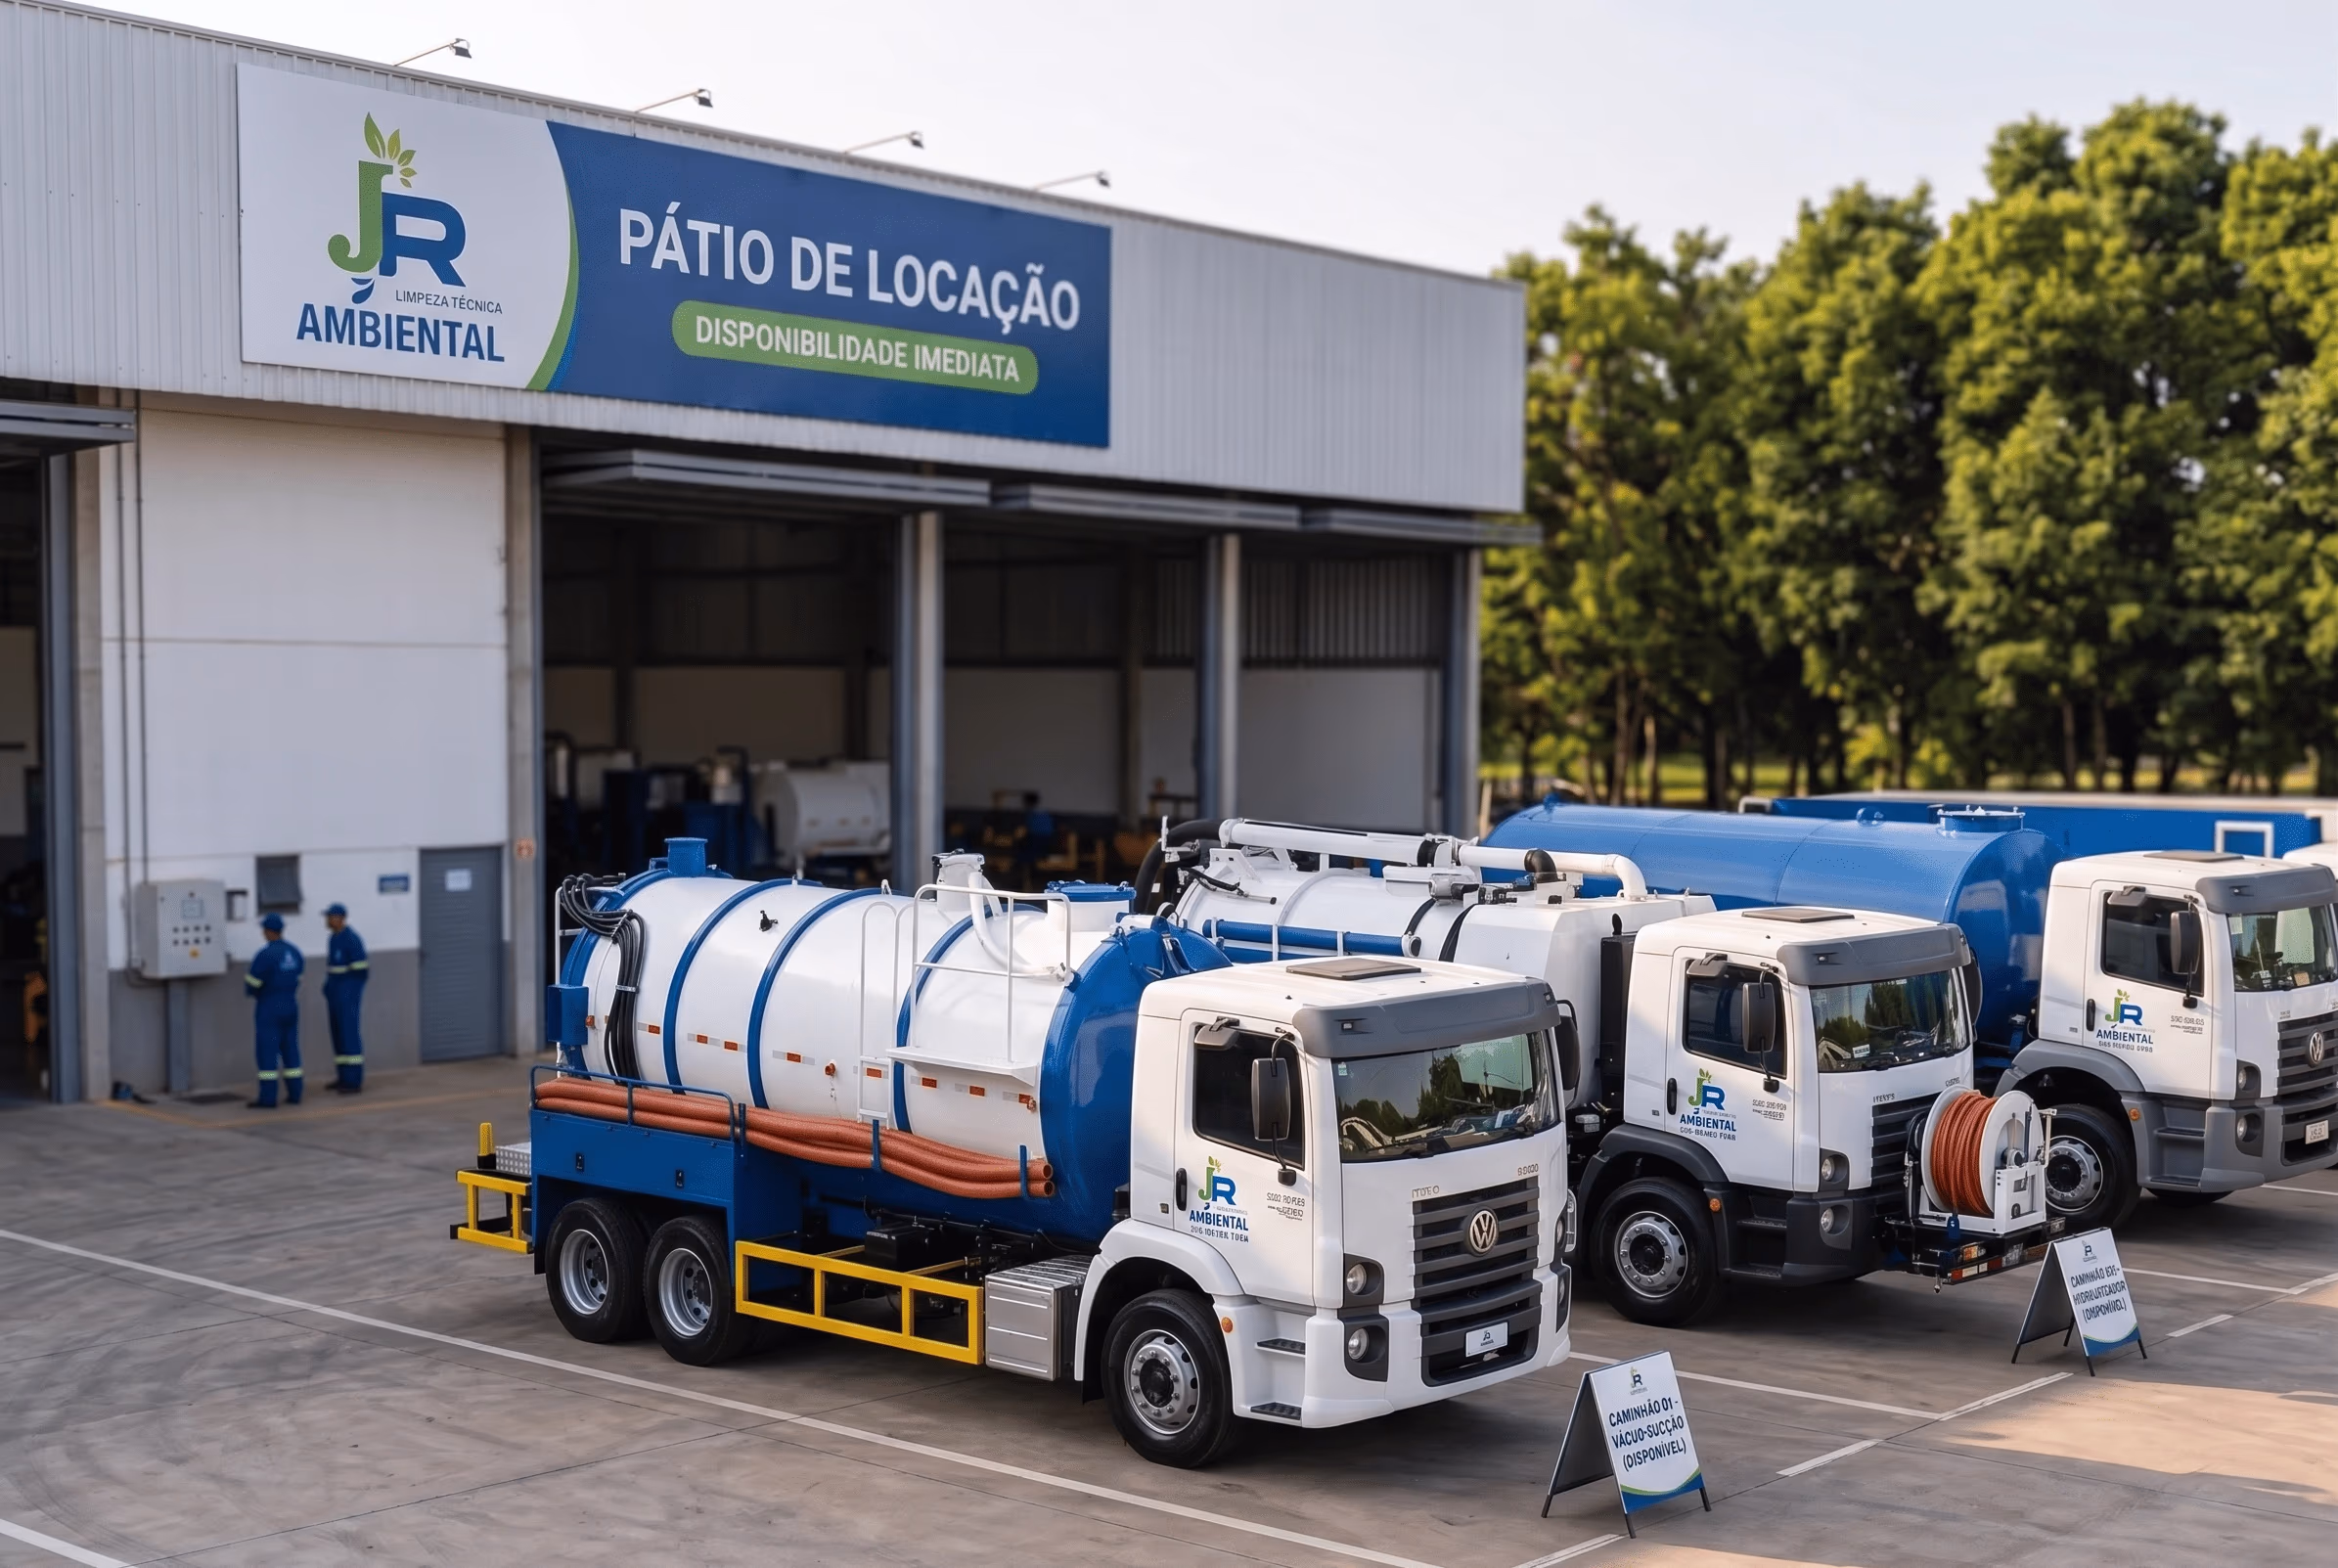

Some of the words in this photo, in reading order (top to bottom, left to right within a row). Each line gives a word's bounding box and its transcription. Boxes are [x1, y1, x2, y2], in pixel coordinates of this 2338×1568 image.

[327, 159, 467, 287] JR
[619, 201, 776, 287] PÁTIO
[789, 237, 852, 298] DE
[868, 248, 1081, 336] LOCAÇÃO
[394, 289, 450, 308] LIMPEZA
[451, 292, 504, 315] TÉCNICA
[296, 303, 505, 364] AMBIENTAL
[696, 315, 909, 369] DISPONIBILIDADE
[912, 342, 1020, 383] IMEDIATA
[2105, 996, 2143, 1026] JR
[2095, 1028, 2154, 1045] AMBIENTAL
[1687, 1077, 1726, 1111] JR
[1680, 1113, 1737, 1132] AMBIENTAL
[1197, 1166, 1236, 1206] JR
[1189, 1209, 1249, 1232] AMBIENTAL
[1609, 1399, 1661, 1427] CAMINHÃO
[1662, 1397, 1674, 1412] 01
[1611, 1414, 1685, 1450] VÁCUO-SUCÇÃO
[1623, 1438, 1687, 1472] (DISPONÍVEL)
